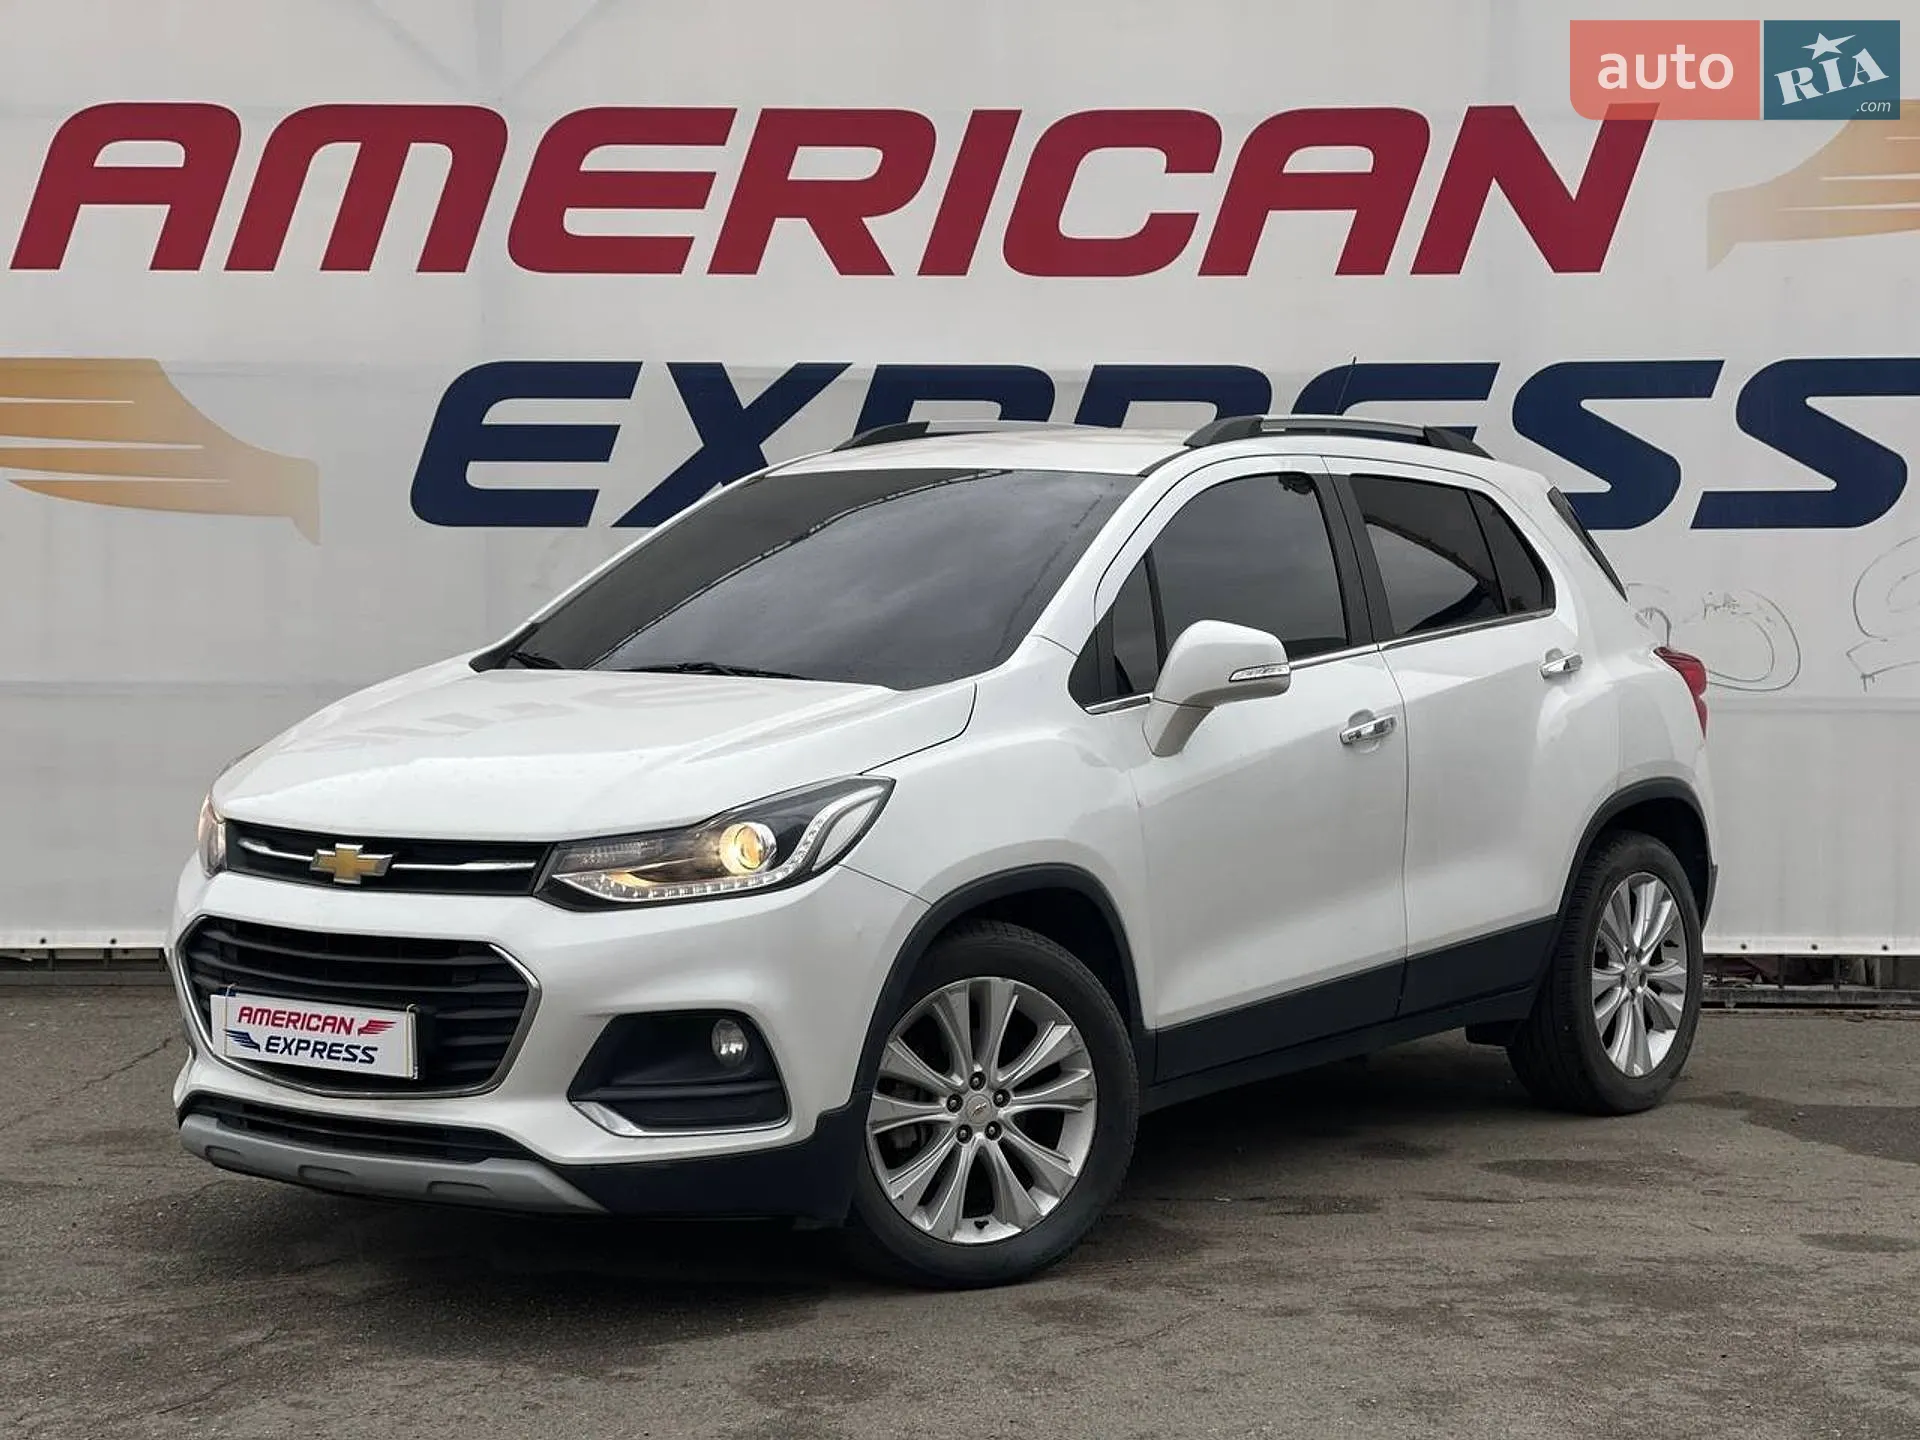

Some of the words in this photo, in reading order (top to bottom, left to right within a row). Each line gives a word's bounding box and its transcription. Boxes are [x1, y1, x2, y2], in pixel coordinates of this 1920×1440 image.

[9, 101, 1661, 277] AMERICAN
[237, 1005, 355, 1035] AMERICAN
[264, 1035, 379, 1065] EXPRESS
